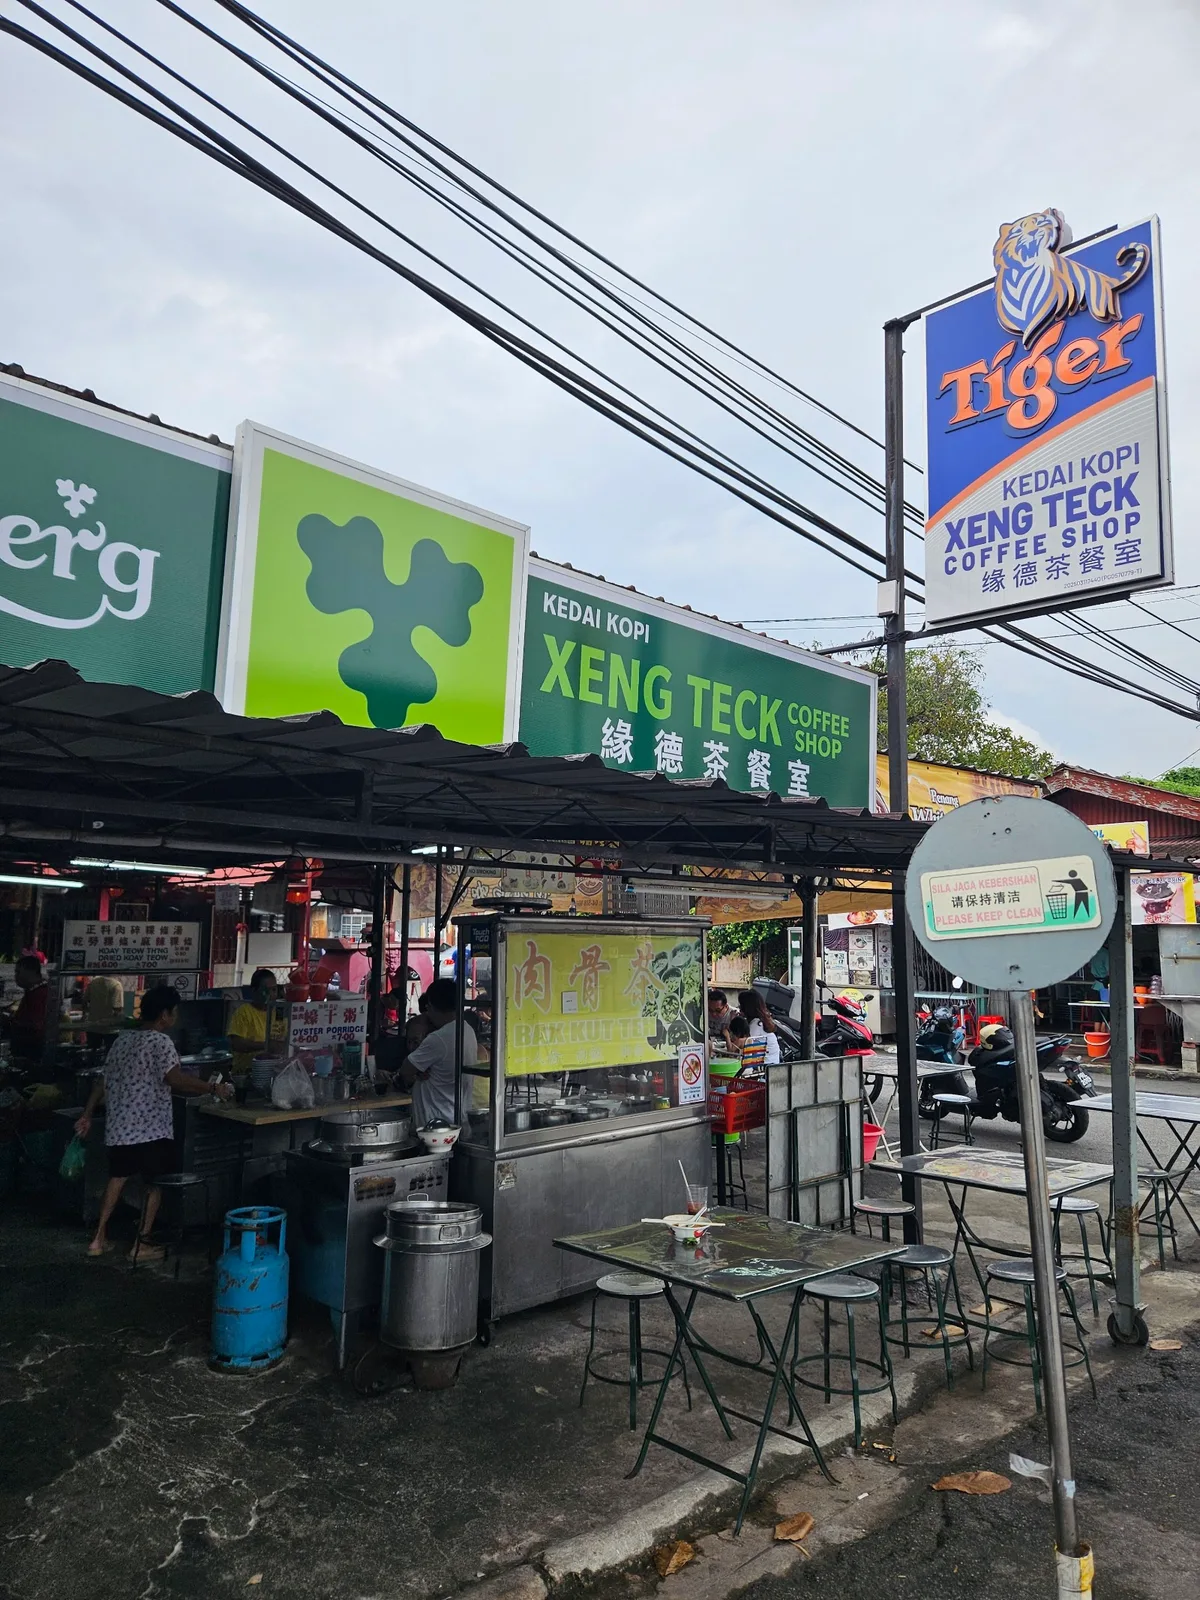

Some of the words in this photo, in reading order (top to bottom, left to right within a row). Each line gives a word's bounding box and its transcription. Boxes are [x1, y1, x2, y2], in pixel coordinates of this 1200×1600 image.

[940, 313, 1144, 430] Tiger
[1003, 461, 1073, 501] KEDAI
[1081, 442, 1140, 479] KOPI
[944, 501, 1033, 553] XENG
[1042, 471, 1140, 528] TECK
[944, 534, 1047, 575] COFFEE
[1062, 511, 1141, 548] SHOP
[981, 539, 1142, 593] 缘德茶餐室
[543, 592, 601, 629] KEDAI
[607, 611, 650, 644] KOPI
[540, 633, 673, 720] XENG
[687, 674, 783, 747] TECK
[787, 702, 850, 738] COFFEE
[794, 730, 843, 759] SHOP
[600, 717, 811, 798] 緣德茶餐室
[930, 788, 959, 807] Penang
[932, 883, 951, 893] SILA
[953, 882, 976, 893] JAGA
[978, 874, 1037, 890] KEBERSIHAN
[951, 890, 1020, 908] 请保持清洁
[935, 912, 974, 926] PLEASE
[976, 911, 1003, 923] KEEP
[1006, 907, 1042, 920] CLEAN
[512, 940, 665, 1014] 肉骨茶
[292, 1027, 323, 1036] OYSTER
[326, 1026, 364, 1034] PORRIDGE
[569, 1019, 615, 1043] KUT
